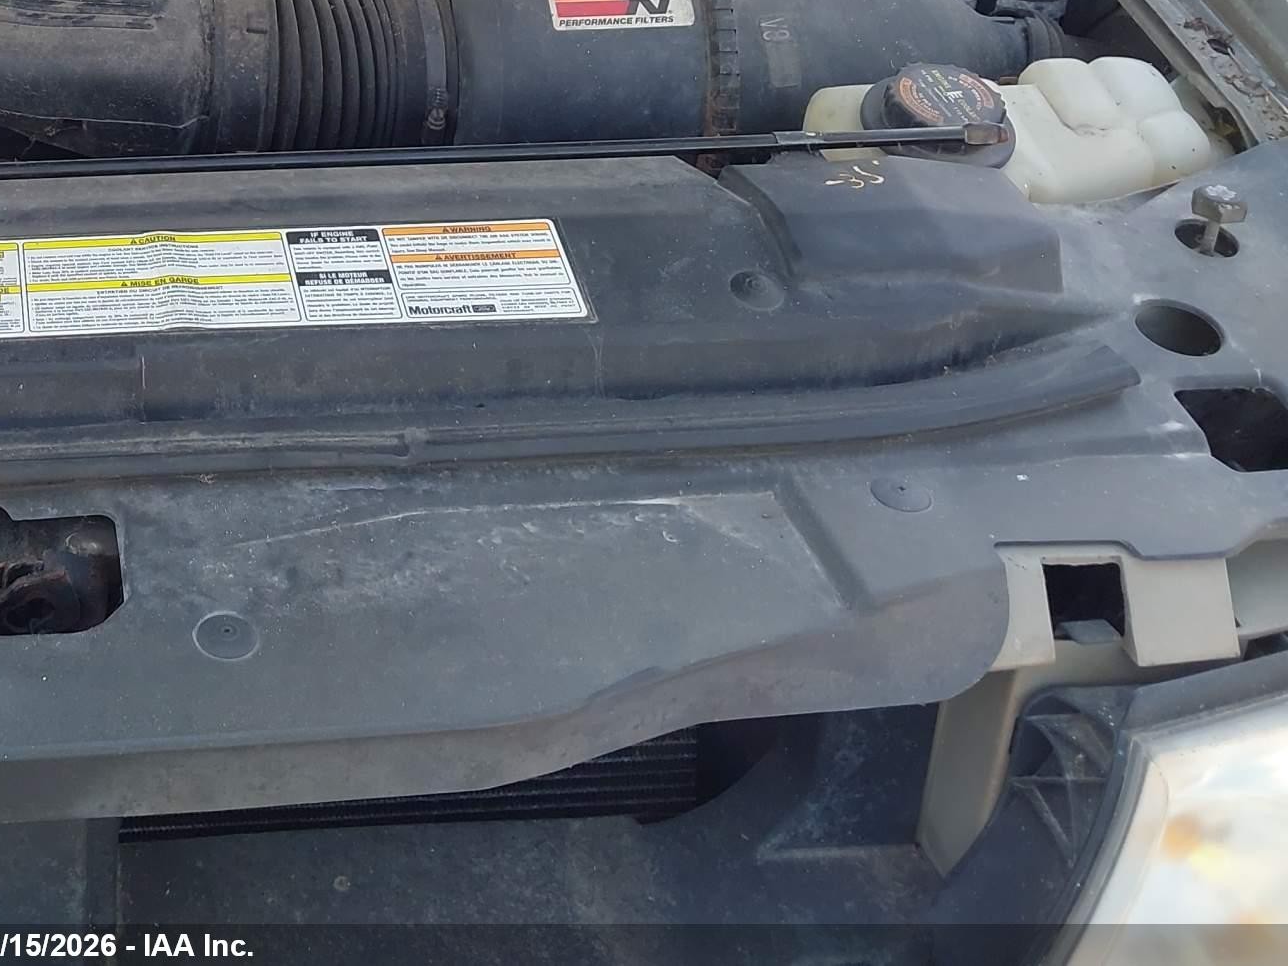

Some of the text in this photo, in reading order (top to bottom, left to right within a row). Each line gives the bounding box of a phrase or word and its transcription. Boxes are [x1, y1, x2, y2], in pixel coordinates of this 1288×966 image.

[559, 15, 674, 27] PERFORMANCE FILTERS
[139, 236, 176, 244] CAUTION
[409, 304, 472, 315] Motorcraft
